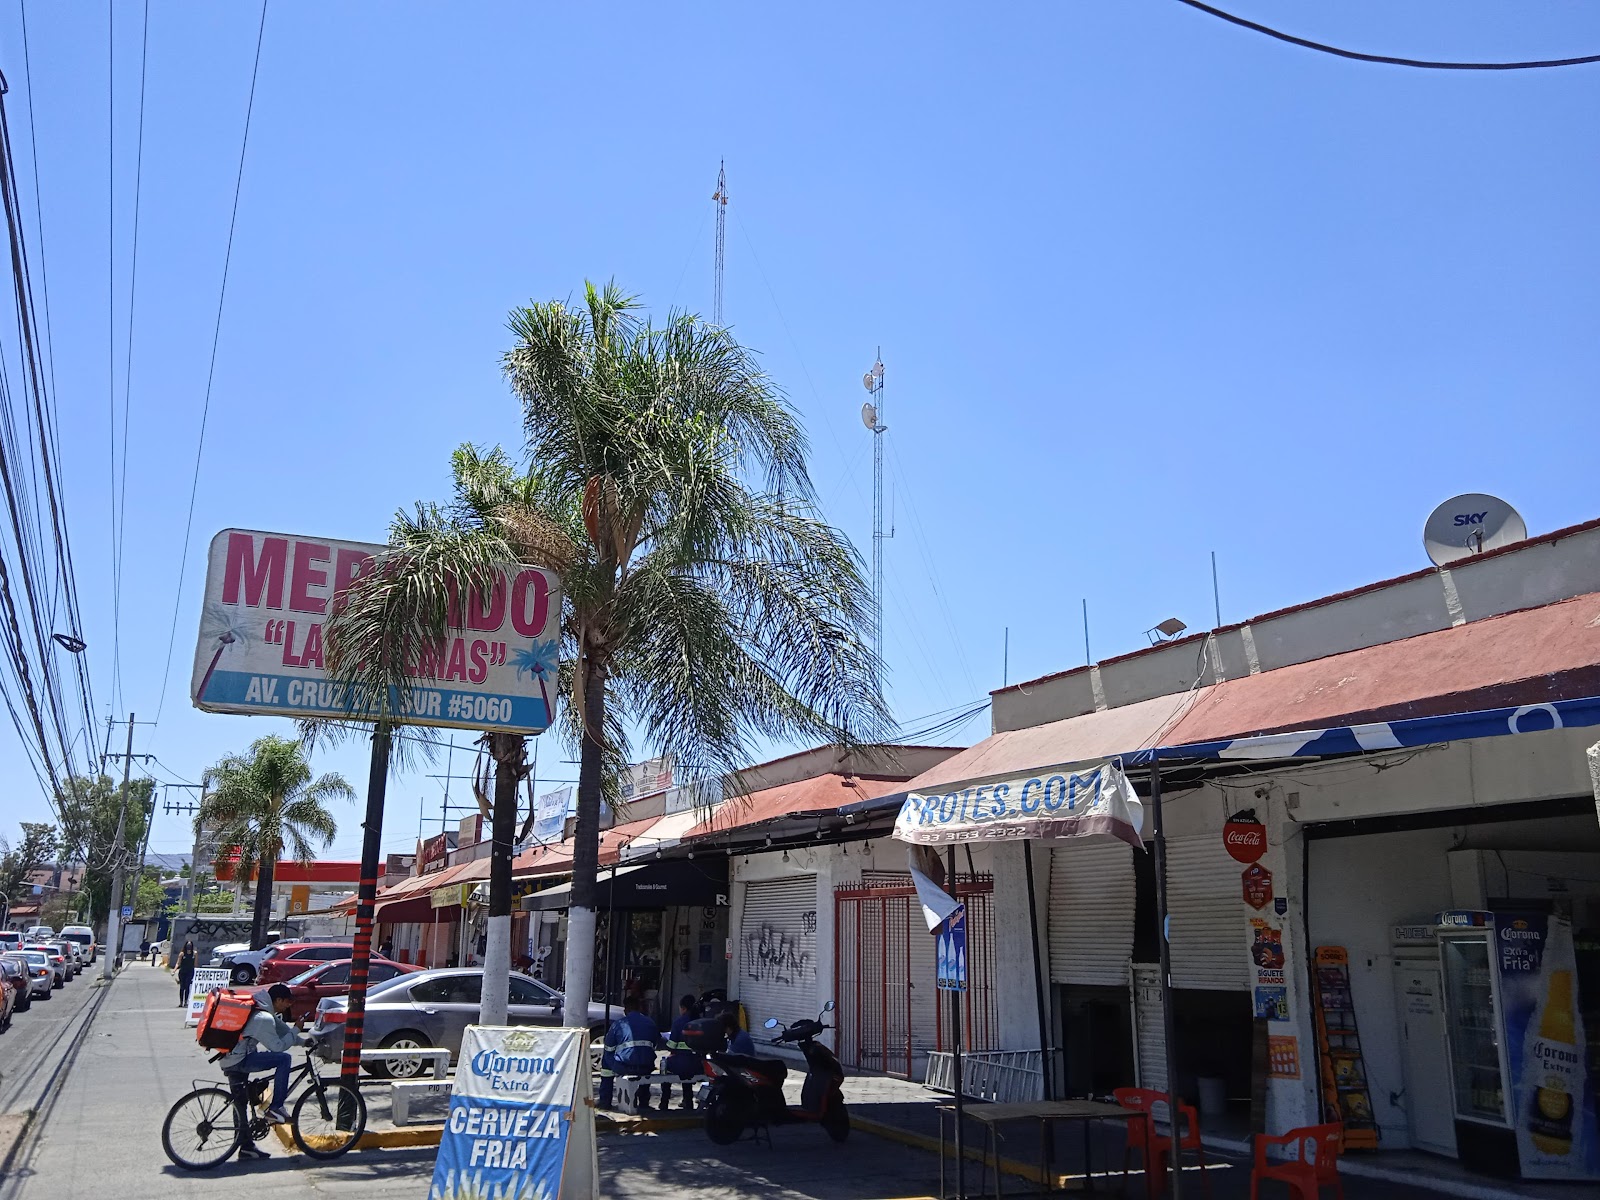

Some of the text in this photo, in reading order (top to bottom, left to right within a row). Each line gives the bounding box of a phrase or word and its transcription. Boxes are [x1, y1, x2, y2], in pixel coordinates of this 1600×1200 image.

[1454, 511, 1488, 526] SKY
[222, 533, 549, 638] MERDO
[263, 618, 507, 684] “LA LMAS”
[245, 676, 279, 703] AV.
[287, 679, 347, 709] CRUZ
[447, 694, 513, 723] #5060
[919, 827, 1026, 842] 33 3133 2322
[715, 894, 728, 906] R
[703, 921, 715, 929] NO
[1442, 913, 1468, 926] Corona
[1501, 928, 1541, 942] Corona
[1533, 1040, 1578, 1064] Corona
[471, 1049, 556, 1080] Corona
[1543, 1059, 1571, 1074] Extra
[491, 1075, 530, 1092] Extra
[450, 1106, 561, 1139] CERVEZA
[469, 1139, 528, 1170] FRIA
